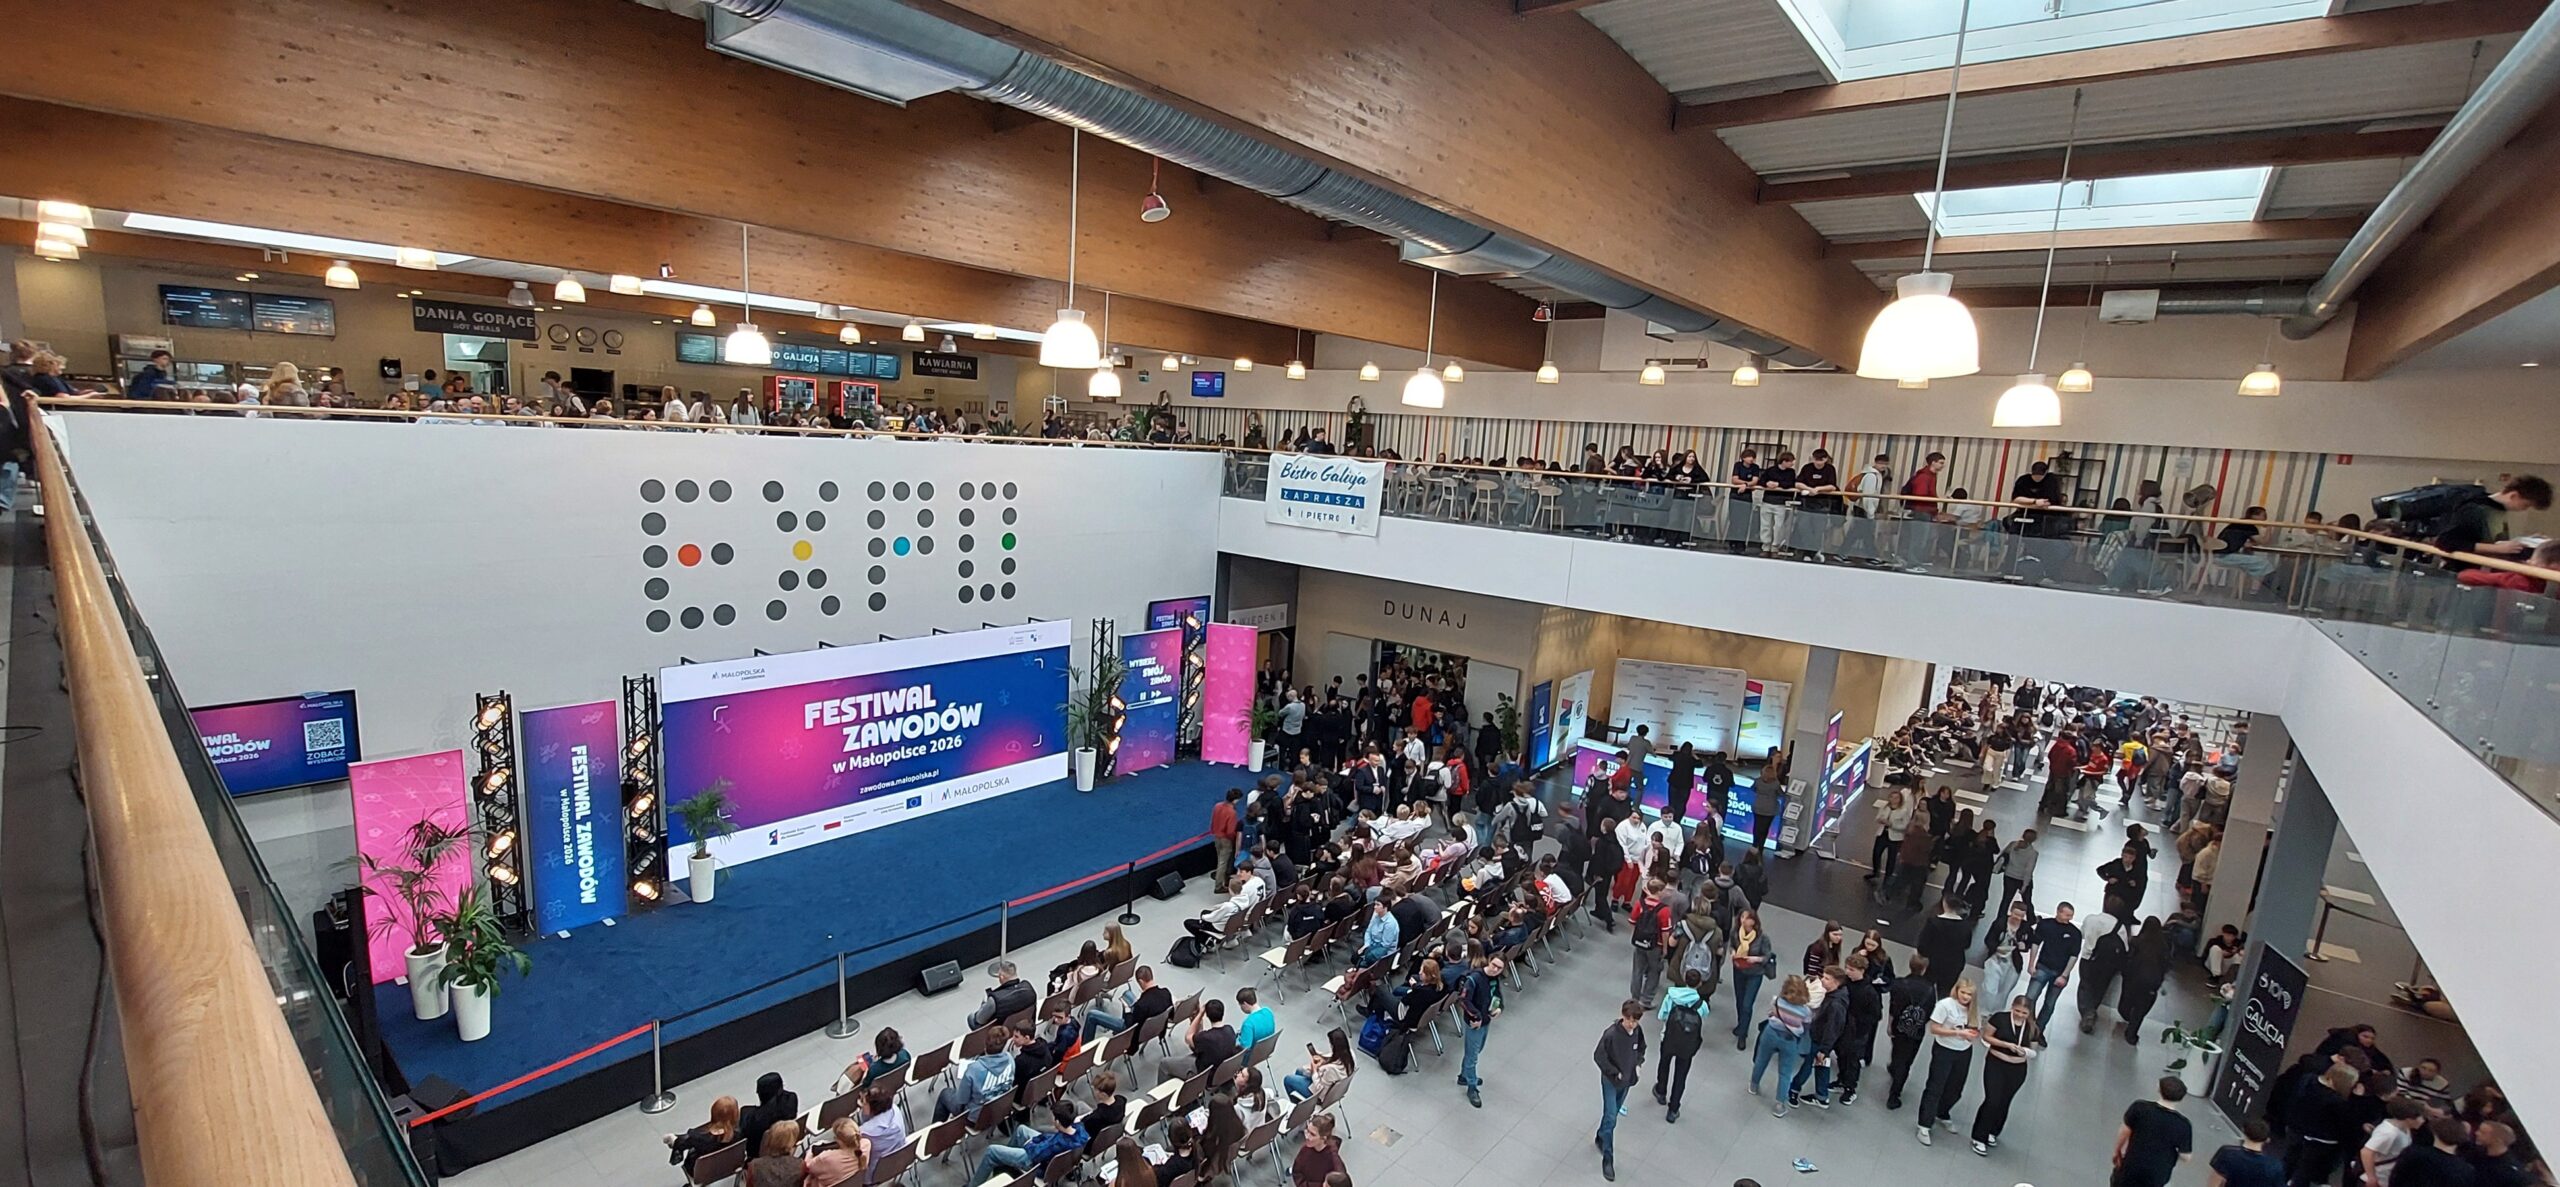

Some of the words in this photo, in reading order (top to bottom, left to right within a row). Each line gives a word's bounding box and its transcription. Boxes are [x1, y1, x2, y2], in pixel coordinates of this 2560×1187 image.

[415, 306, 467, 321] DANIA
[472, 312, 535, 329] GORĄCE
[783, 351, 820, 363] GALICJA
[919, 357, 972, 370] KAWIARNIA
[1280, 462, 1318, 481] Bistro
[1283, 490, 1361, 507] ZAPRASZA
[639, 478, 1018, 634] EXPO
[1383, 600, 1467, 629] DUNAJ
[804, 684, 937, 730] FESTIWAL
[842, 702, 983, 753] ZAWODÓW
[206, 739, 271, 758] WODÓW
[239, 752, 260, 761] 2026
[306, 749, 346, 761] ZOBACZ
[832, 762, 847, 774] w
[849, 743, 927, 771] Małopolsce
[929, 734, 963, 754] 2026
[560, 788, 568, 797] w
[571, 744, 592, 821] FESTIWAL
[953, 776, 1010, 798] MAŁOPOLSKA
[563, 843, 574, 866] 2026
[576, 821, 599, 905] ZAWODÓW
[2245, 1005, 2285, 1050] GALICJA
